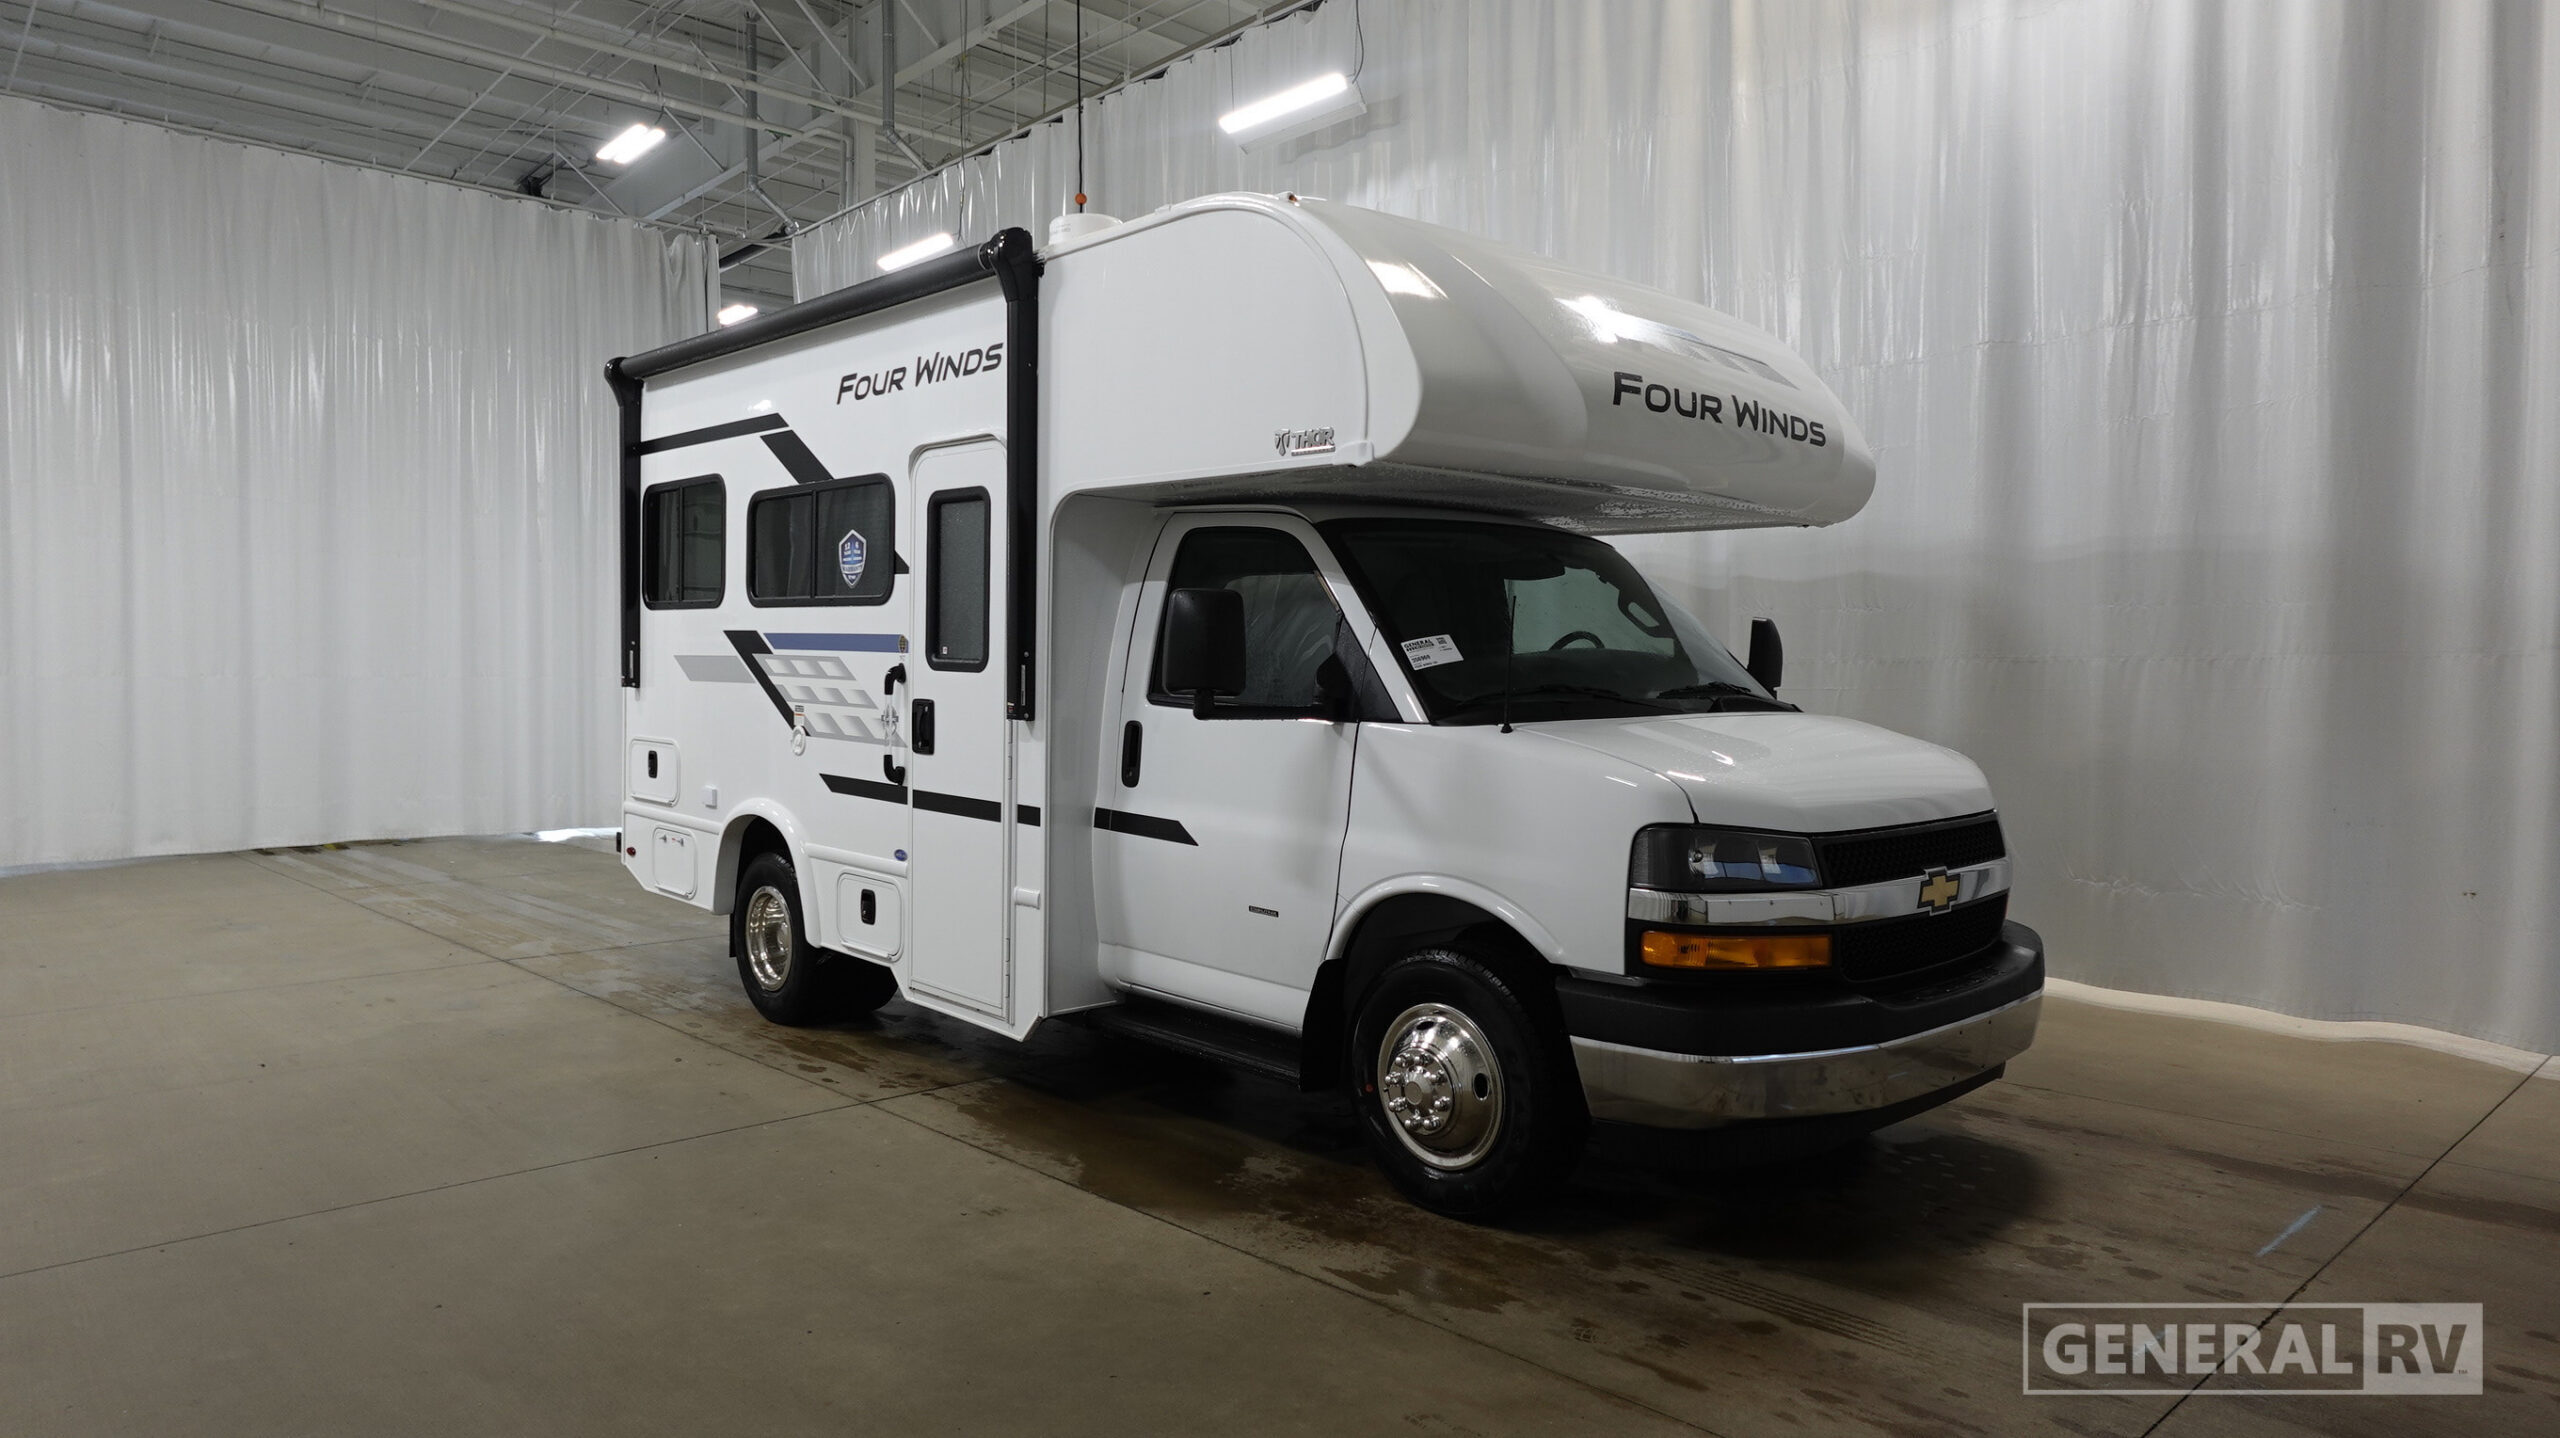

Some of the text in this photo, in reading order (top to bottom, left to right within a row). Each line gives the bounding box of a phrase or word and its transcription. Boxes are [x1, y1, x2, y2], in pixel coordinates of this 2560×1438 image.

[836, 342, 1004, 405] FOUR WINDS
[1612, 371, 1827, 447] FOUR WINDS
[1291, 427, 1335, 449] THOR
[1404, 639, 1432, 648] GENERAL
